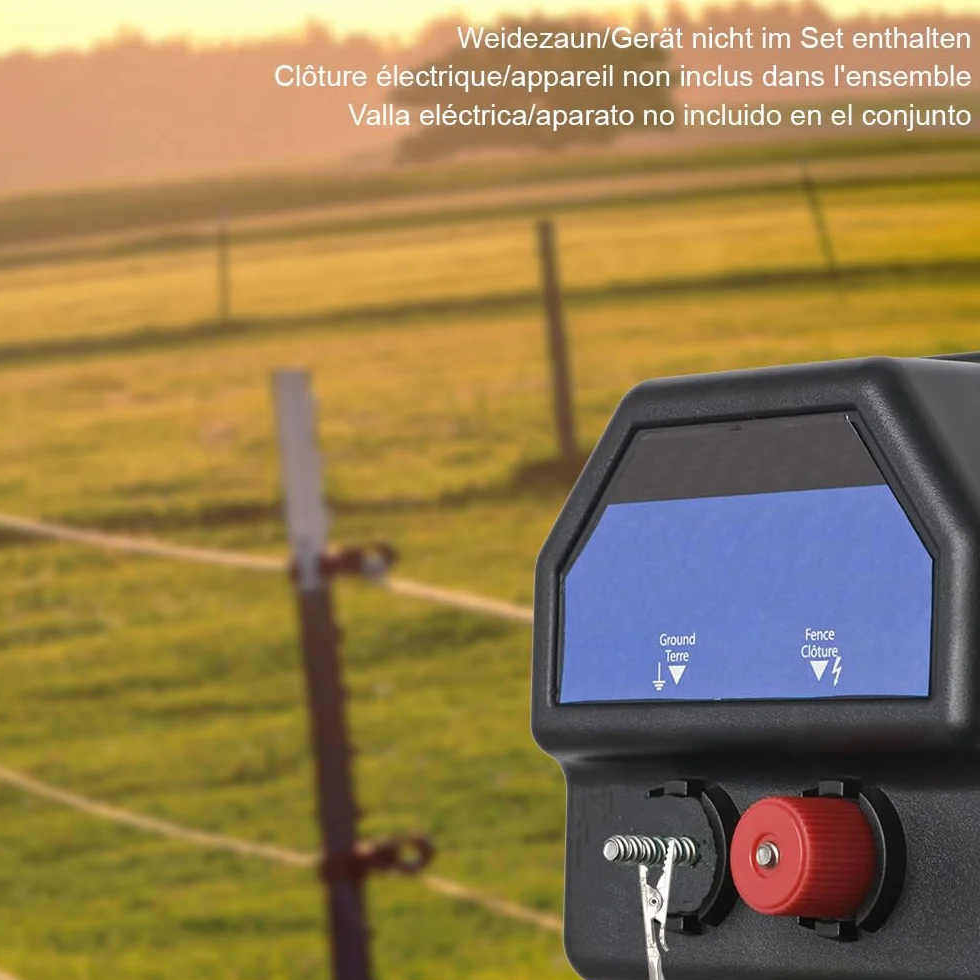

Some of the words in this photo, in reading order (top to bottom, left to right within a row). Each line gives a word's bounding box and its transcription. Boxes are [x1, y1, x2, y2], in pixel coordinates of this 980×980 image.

[659, 632, 696, 646] Ground
[805, 628, 835, 641] Fence
[664, 649, 689, 662] Terre
[800, 644, 839, 658] Clôture
